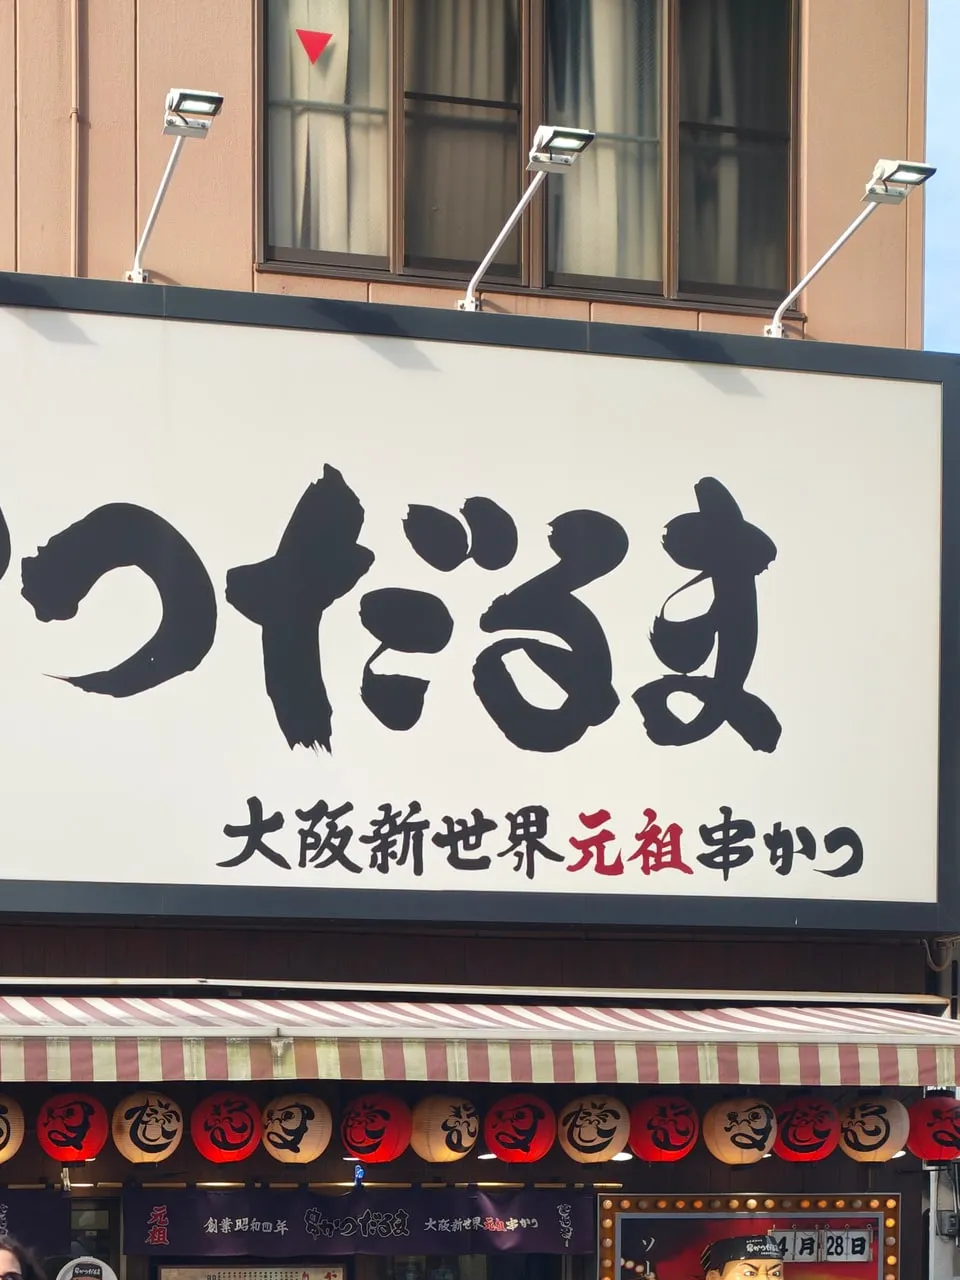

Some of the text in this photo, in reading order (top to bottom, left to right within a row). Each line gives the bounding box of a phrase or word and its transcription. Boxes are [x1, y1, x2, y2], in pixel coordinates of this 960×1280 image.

[216, 796, 864, 882] 大阪新世界元祖串かつ
[145, 1205, 170, 1245] 元祖
[203, 1218, 289, 1236] 創業昭和四年
[304, 1207, 409, 1240] 串かつだるま
